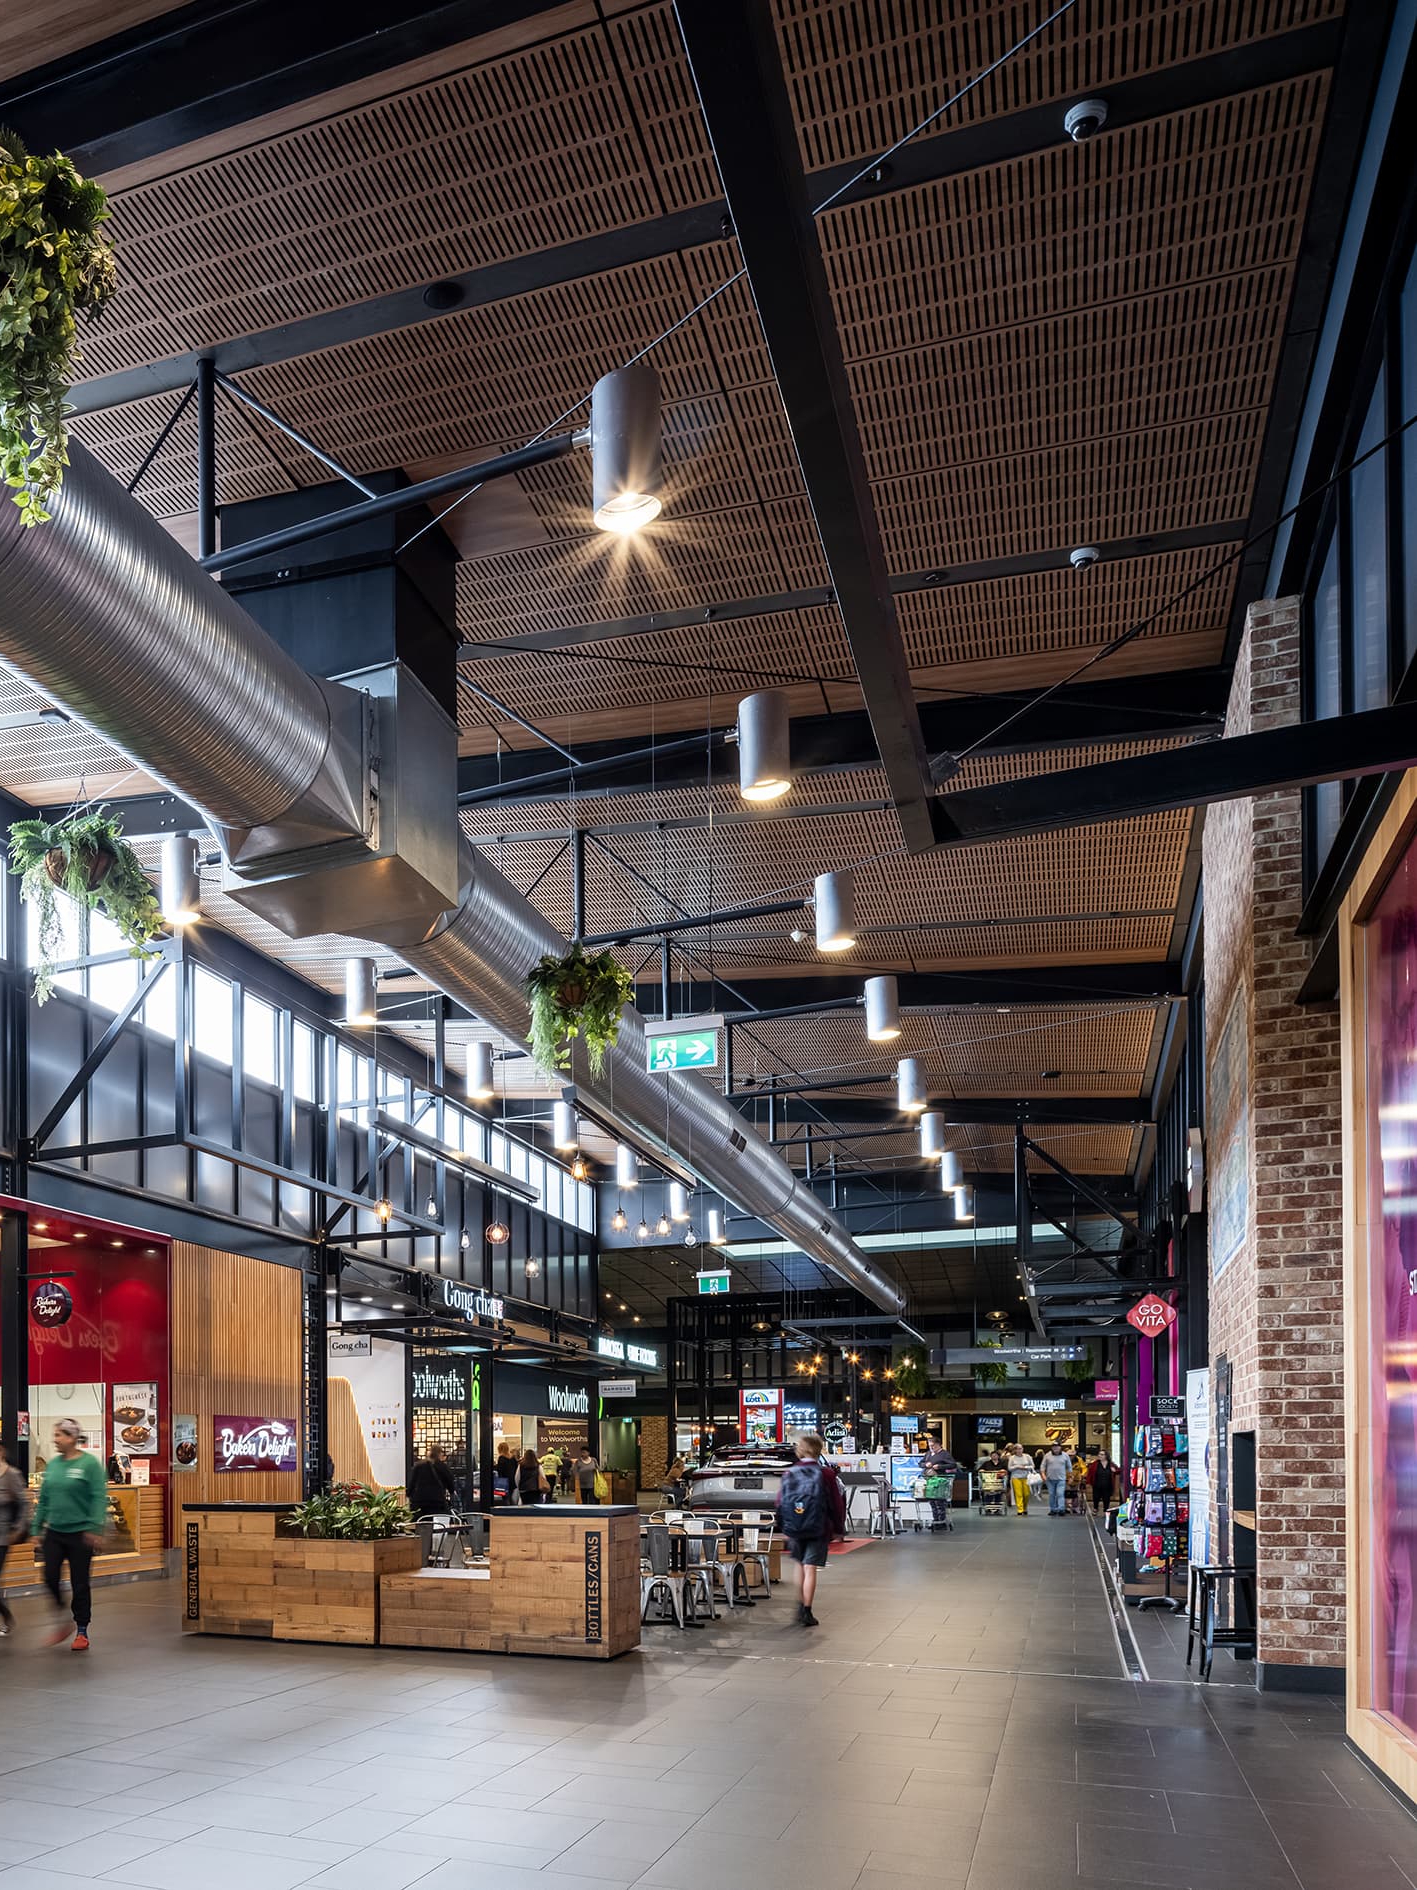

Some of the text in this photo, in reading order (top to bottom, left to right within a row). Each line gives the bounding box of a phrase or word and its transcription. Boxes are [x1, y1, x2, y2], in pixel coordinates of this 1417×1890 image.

[34, 1296, 57, 1309] Bakers
[444, 1279, 474, 1321] Gong
[1138, 1304, 1163, 1316] GO
[39, 1305, 61, 1317] Delight
[1135, 1316, 1167, 1326] VITA
[332, 1341, 369, 1351] Gong cha
[548, 1385, 589, 1414] Woolworth
[221, 1428, 256, 1461] Bakers
[258, 1430, 293, 1466] Delight
[188, 1525, 198, 1617] GENERAL WASTE
[587, 1535, 599, 1640] BOTTLES/CANS
